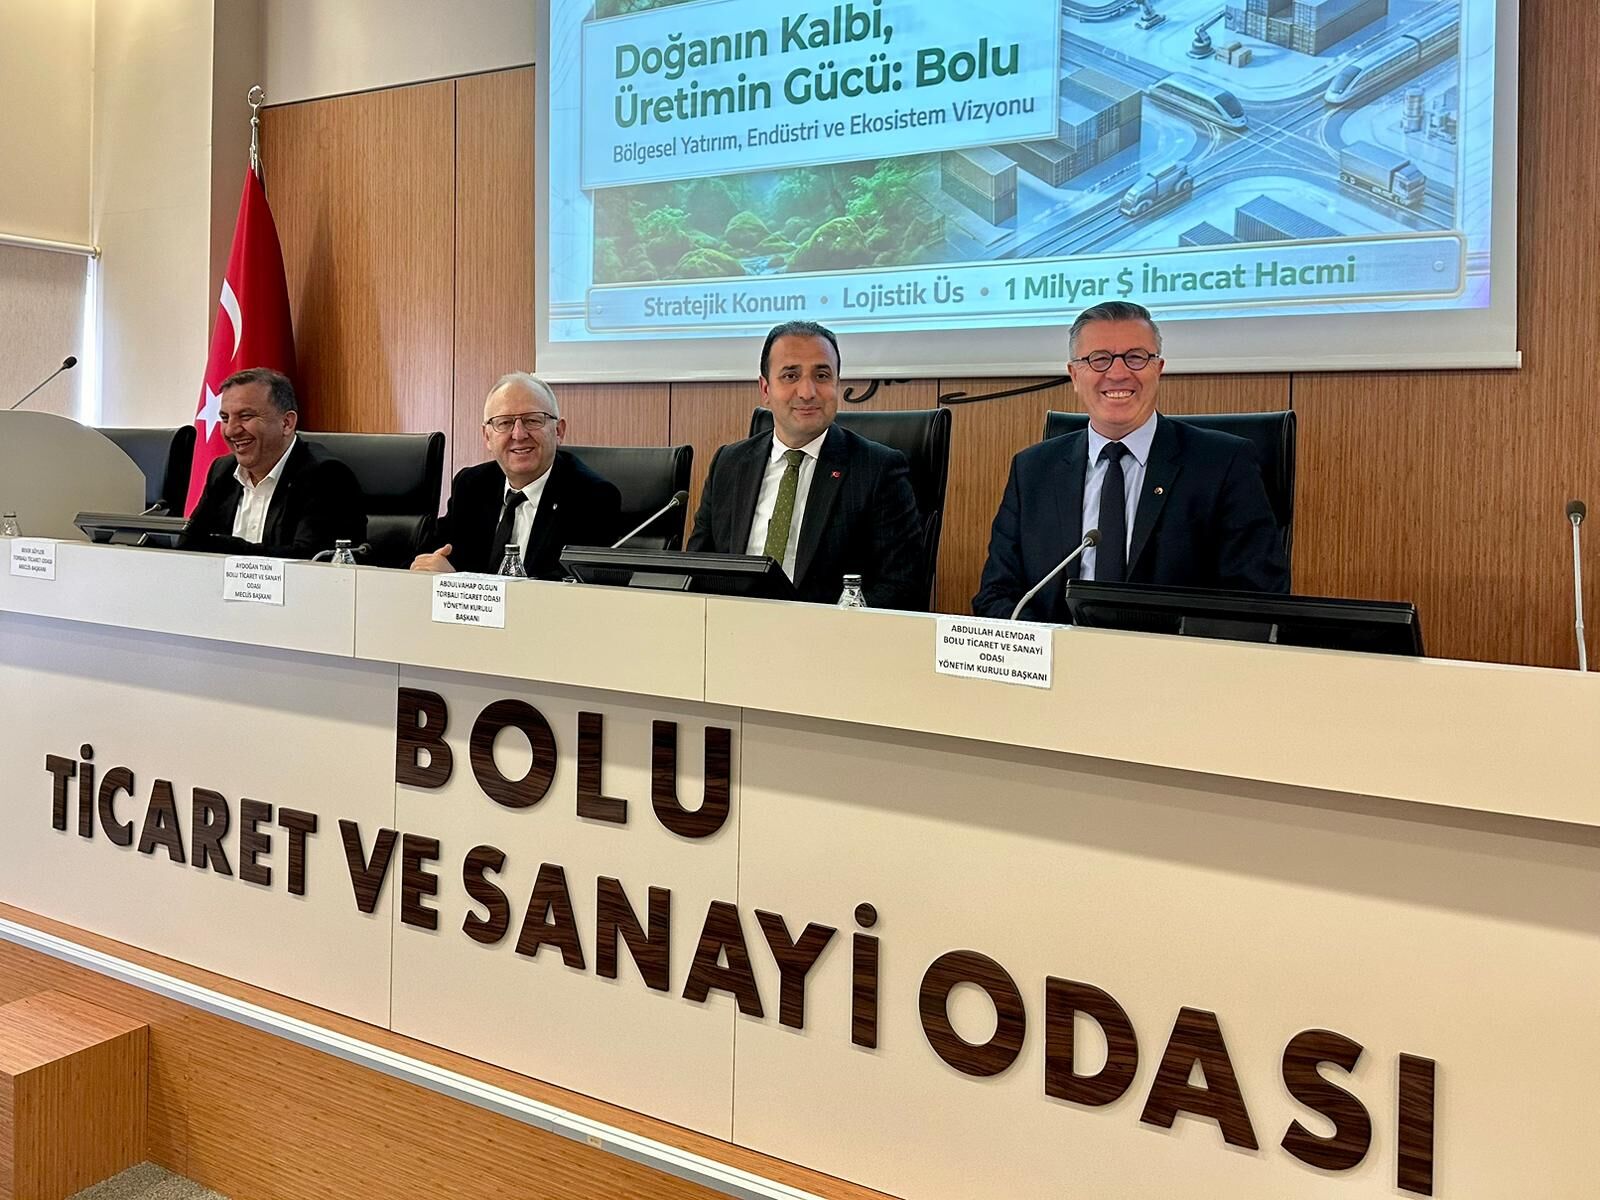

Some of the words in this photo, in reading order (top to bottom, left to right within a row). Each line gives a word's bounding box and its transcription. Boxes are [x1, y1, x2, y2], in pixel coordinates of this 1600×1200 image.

[615, 26, 768, 81] Doğanın
[780, 0, 893, 53] Kalbi,
[614, 73, 771, 128] Üretimin
[783, 54, 902, 109] Gücü:
[916, 38, 1019, 88] Bolu
[613, 139, 677, 166] Bölgesel
[681, 133, 743, 156] Yatırım,
[747, 121, 819, 148] Endüstri
[823, 121, 845, 139] ve
[850, 106, 946, 134] Ekosistem
[952, 96, 1035, 126] Vizyonu
[643, 295, 727, 321] Stratejik
[731, 292, 806, 314] Konum
[842, 285, 927, 310] Lojistik
[933, 279, 965, 304] Üs
[1004, 278, 1015, 301] 1
[1024, 270, 1109, 304] Milyar
[1115, 266, 1133, 299] $
[1142, 261, 1246, 293] İhracat
[1254, 256, 1357, 287] Hacmi
[436, 590, 459, 598] TORBALI
[460, 592, 482, 600] TİCARET
[440, 580, 476, 589] ABDULVAHAP
[443, 601, 469, 610] YÖNETİM
[455, 613, 480, 622] BAŞKANI
[951, 624, 994, 636] ABDULLAH
[995, 630, 1036, 642] ALEMDAR
[943, 635, 965, 646] BOLU
[966, 637, 999, 650] TİCARET
[1000, 643, 1011, 652] VE
[1012, 643, 1044, 656] SANAYİ
[979, 652, 1005, 663] ODASI
[938, 658, 975, 672] YÖNETİM
[976, 664, 1010, 677] KURULU
[1011, 669, 1048, 681] BAŞKANI
[395, 686, 732, 839] BOLU
[45, 743, 318, 896] TİCARET
[338, 818, 440, 932] VE
[462, 844, 880, 1050] SANAYİ
[918, 949, 1437, 1198] ODASI
